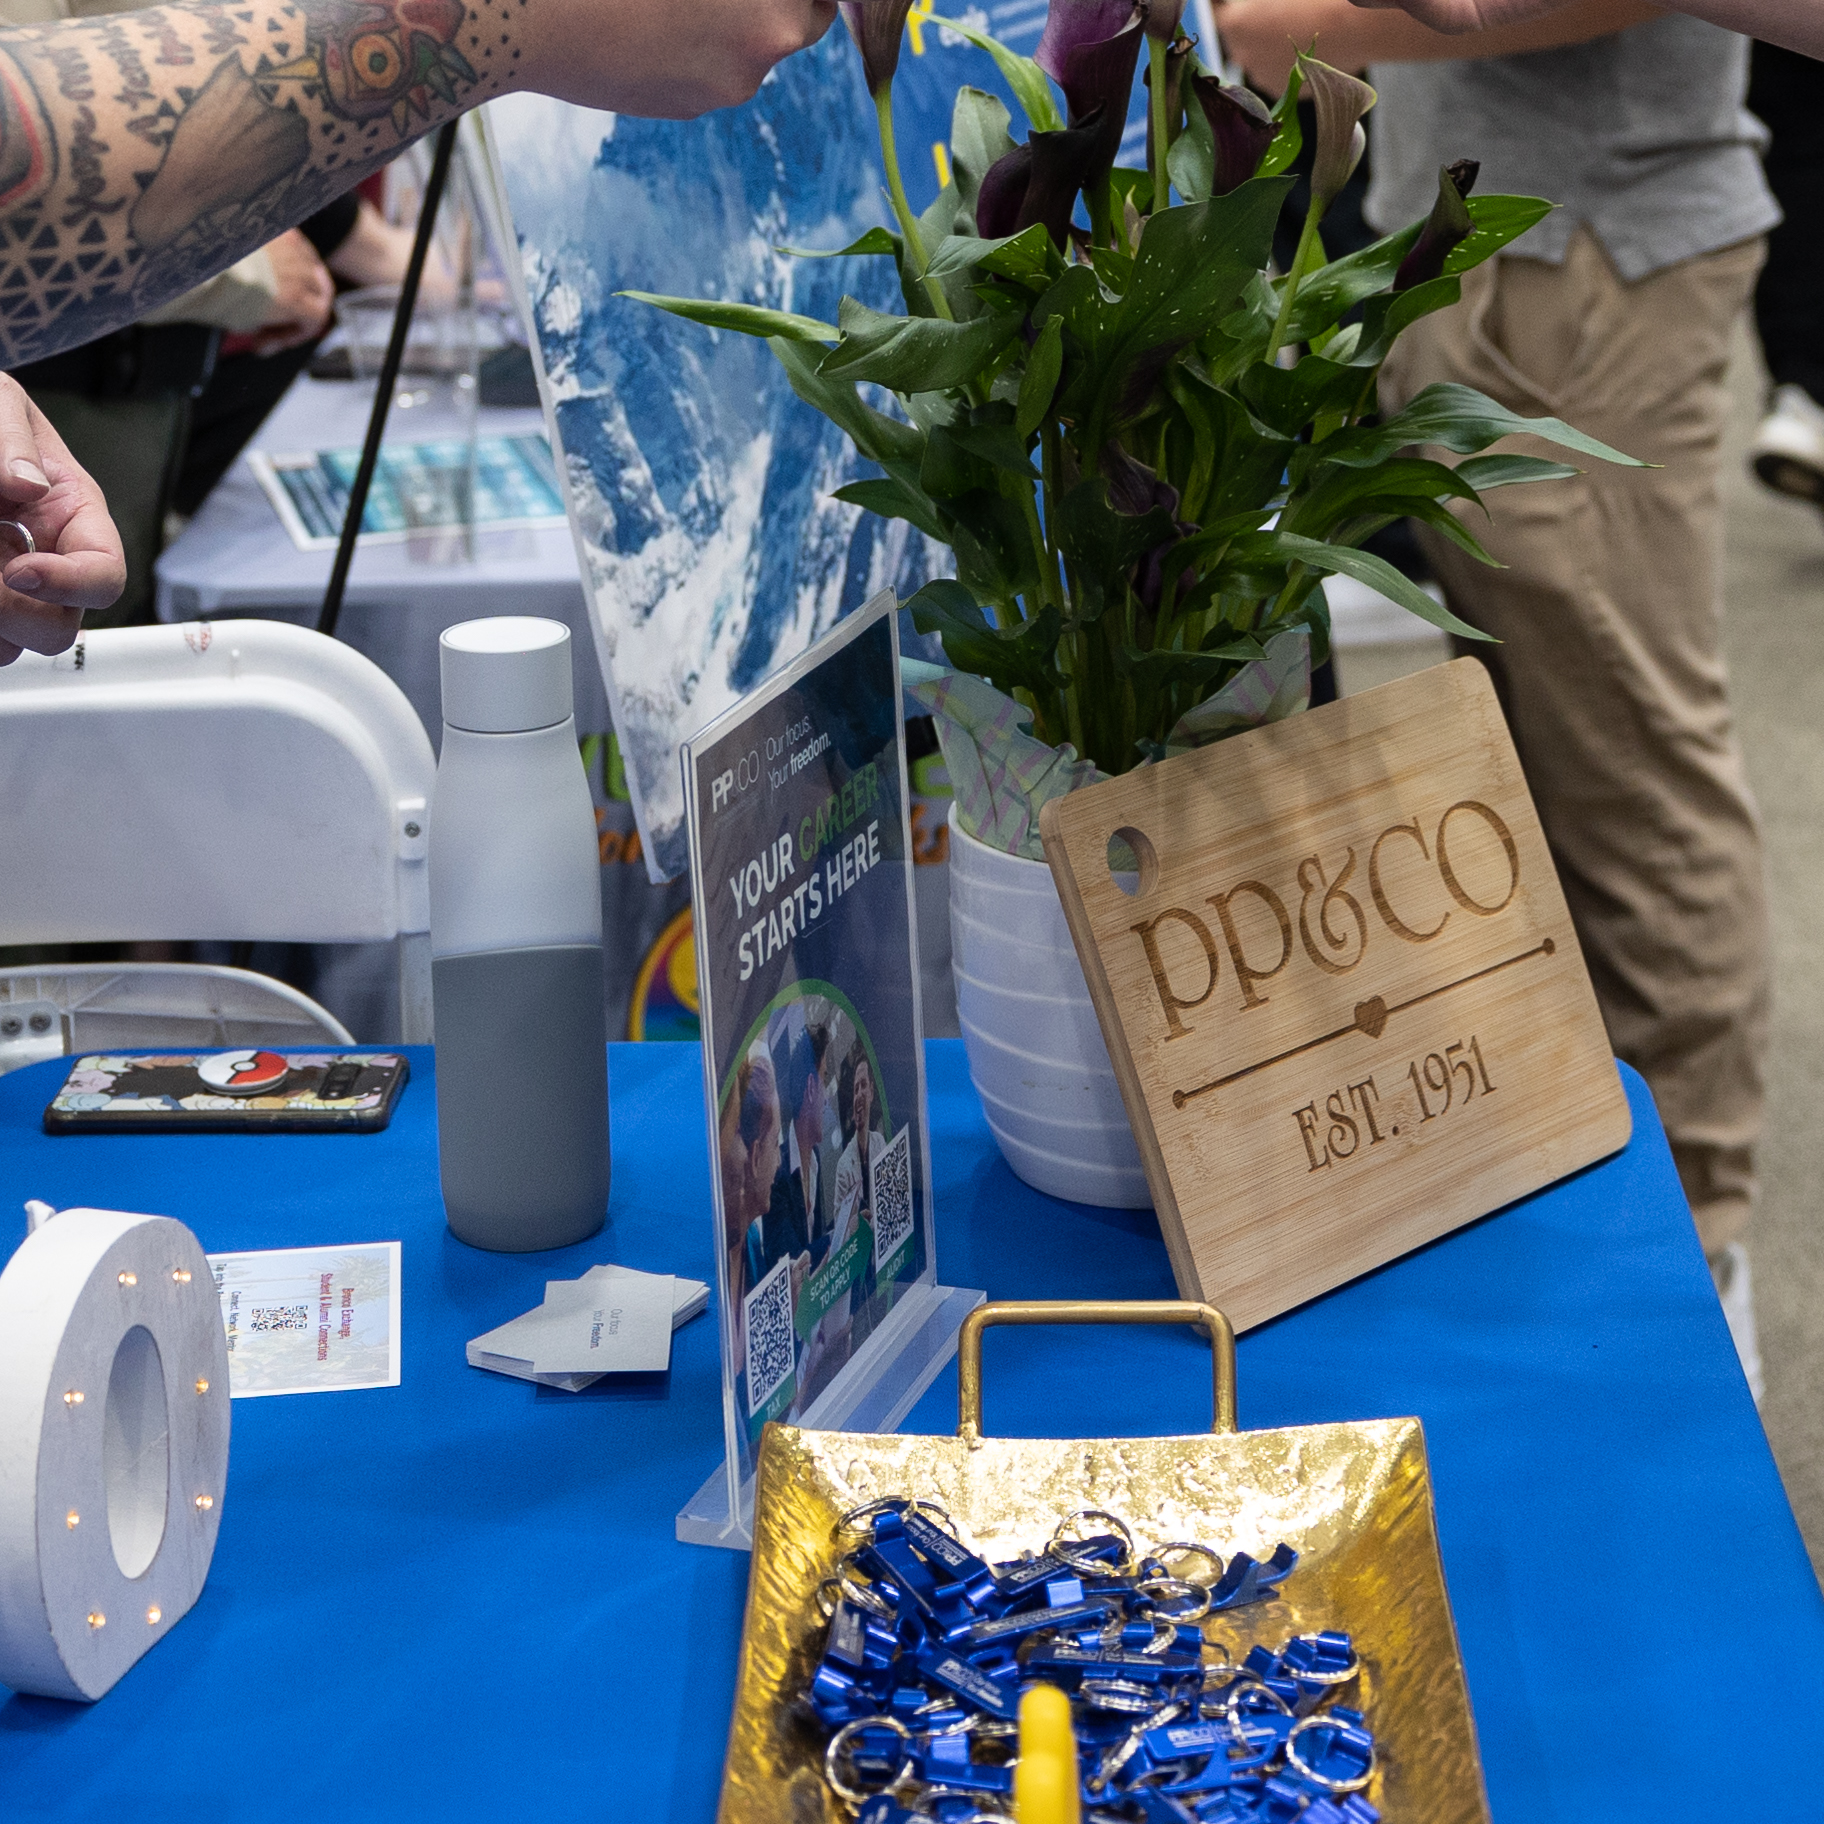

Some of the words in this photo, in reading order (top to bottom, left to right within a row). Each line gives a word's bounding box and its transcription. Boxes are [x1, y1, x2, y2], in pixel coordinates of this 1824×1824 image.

[766, 736, 786, 762] Our
[767, 764, 790, 794] Your
[790, 731, 832, 776] freedom.
[729, 832, 796, 920] YOUR
[798, 761, 880, 863] CAREER
[738, 872, 823, 982] STARTS
[825, 819, 882, 906] HERE
[1129, 796, 1521, 1042] PP&CO
[1291, 1071, 1403, 1175] EST.
[1407, 1033, 1498, 1124] 1951
[809, 1272, 830, 1303] SCAN
[829, 1260, 841, 1282] QR
[840, 1237, 860, 1271] CODE
[885, 1249, 906, 1282] AUDIT
[319, 1272, 333, 1296] Student
[339, 1287, 354, 1309] Bronco
[819, 1292, 832, 1310] TO
[831, 1267, 851, 1299] APPLY
[317, 1302, 331, 1323] Alumni
[337, 1309, 354, 1340] Exchange,
[590, 1308, 604, 1322] Your
[609, 1308, 622, 1320] Our
[315, 1324, 330, 1362] Connections
[588, 1322, 604, 1350] Freedom.
[765, 1394, 782, 1419] TAX
